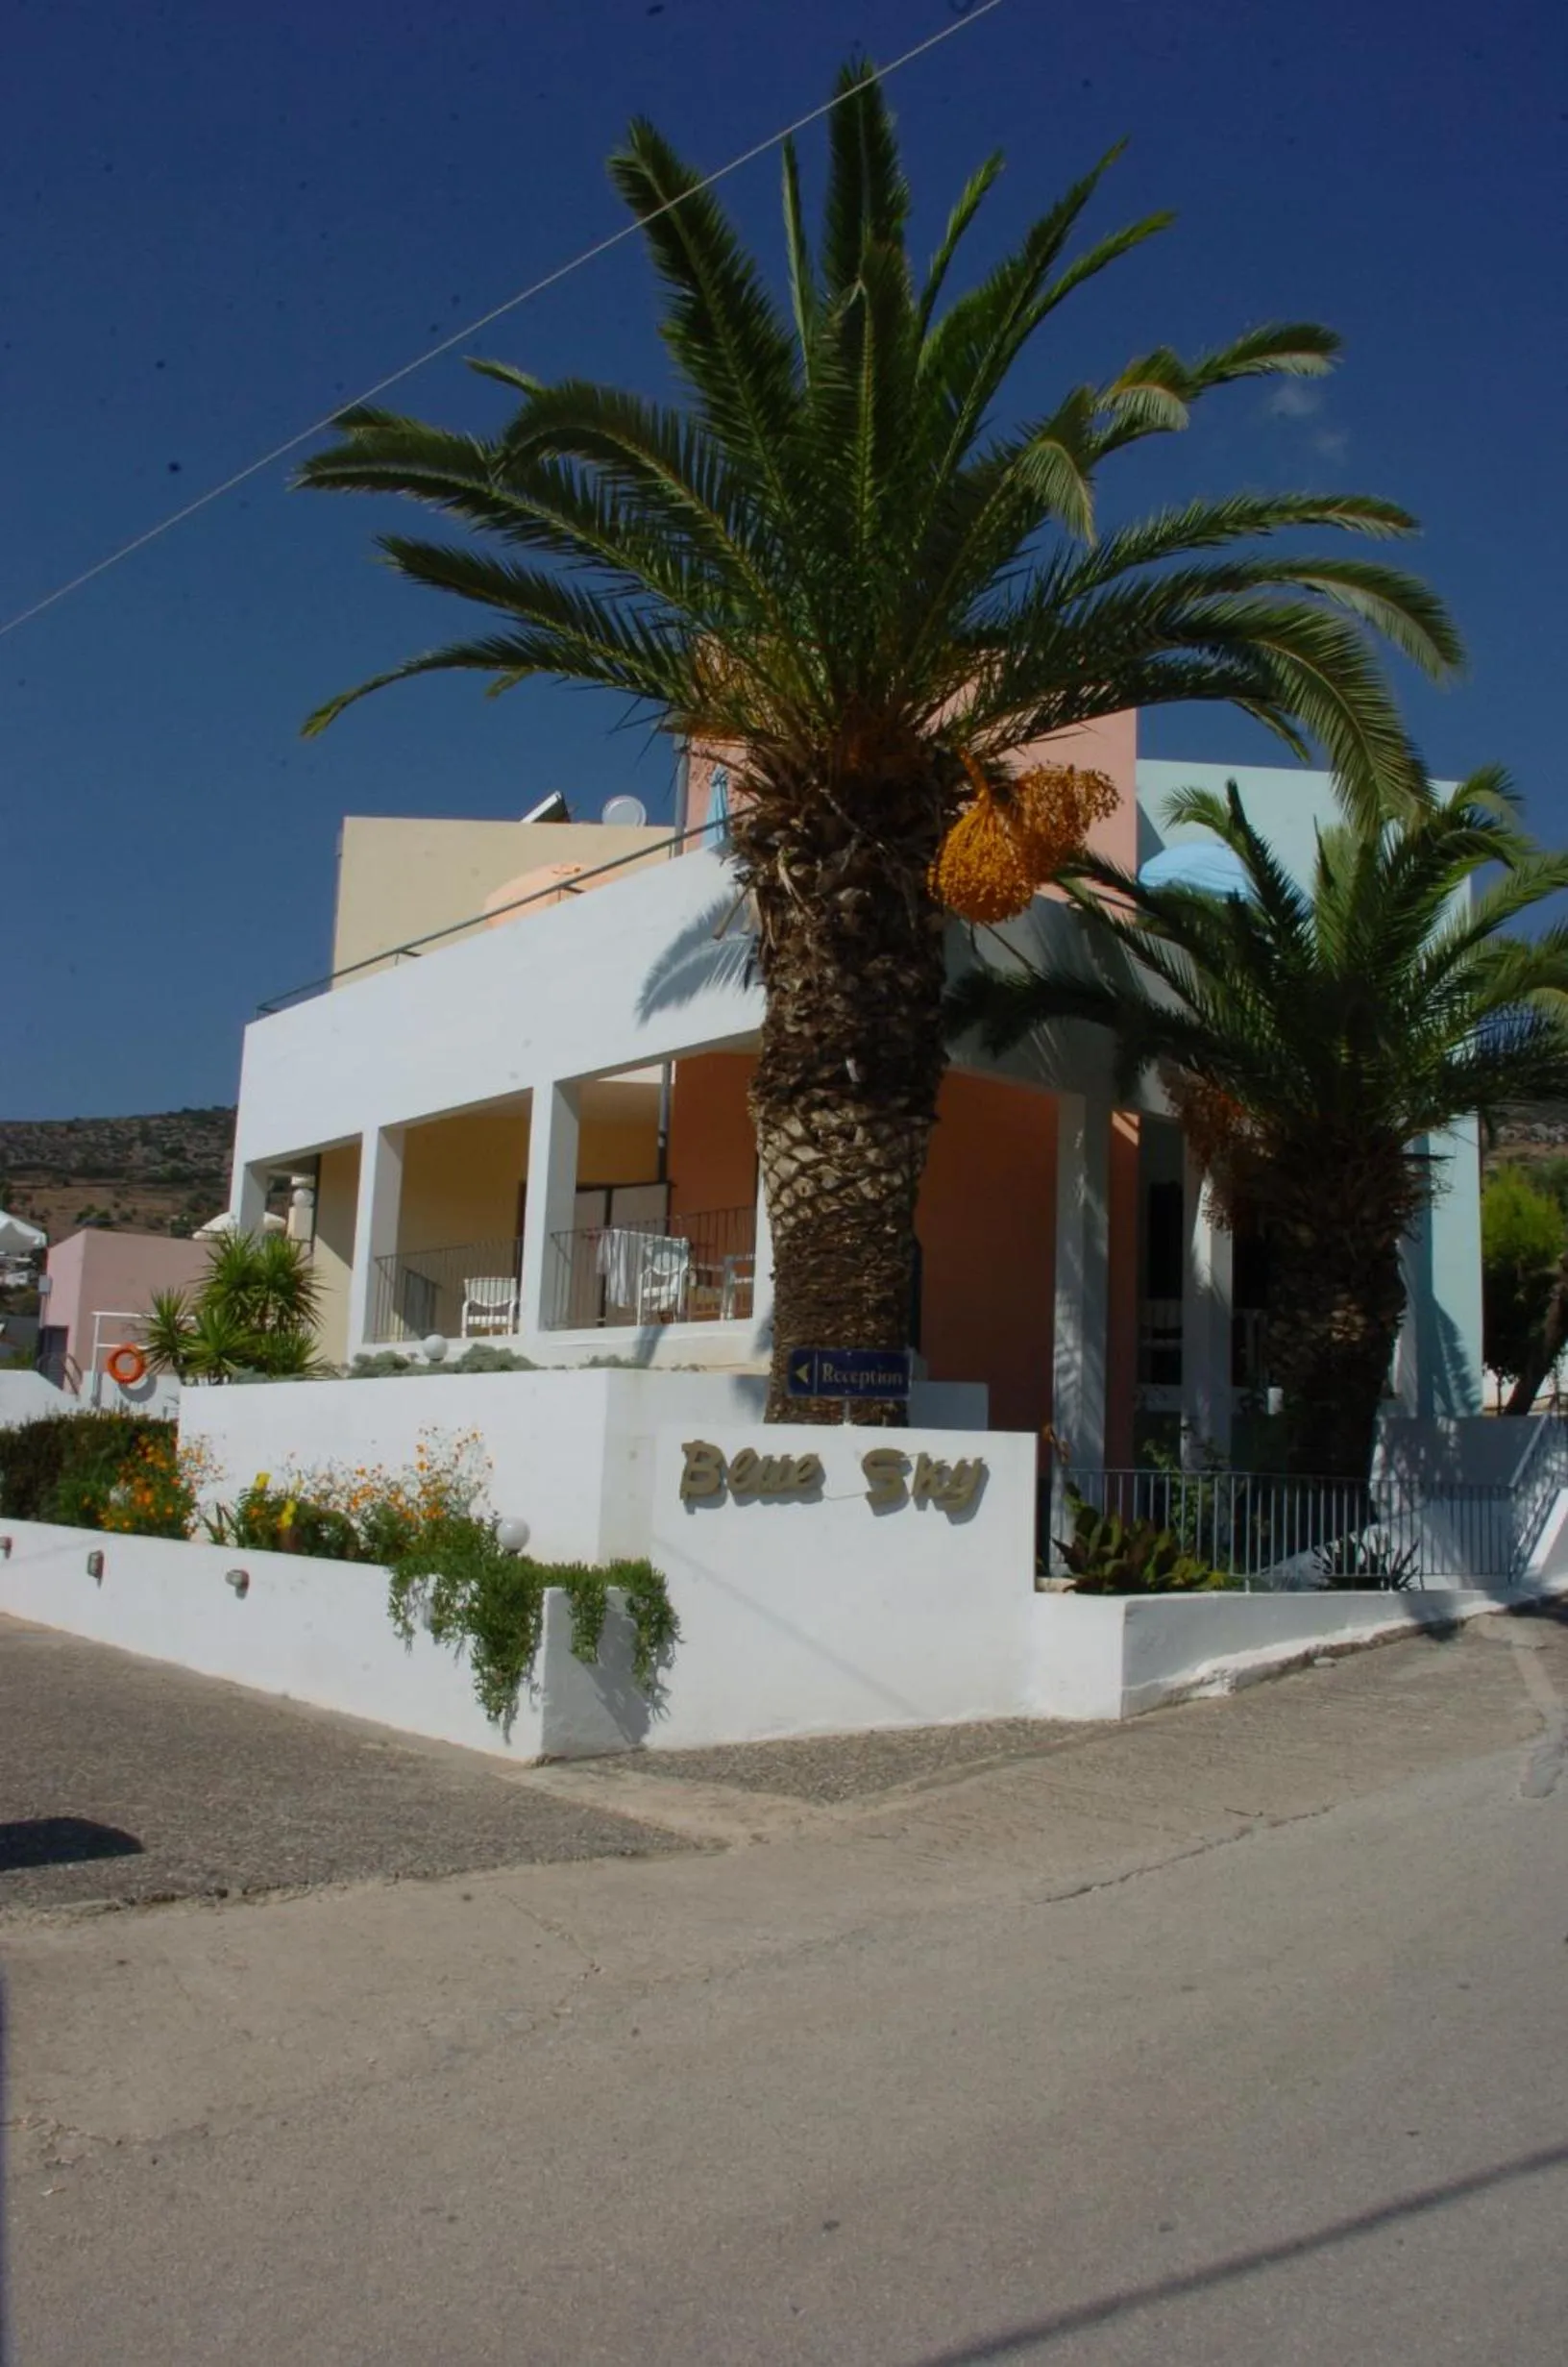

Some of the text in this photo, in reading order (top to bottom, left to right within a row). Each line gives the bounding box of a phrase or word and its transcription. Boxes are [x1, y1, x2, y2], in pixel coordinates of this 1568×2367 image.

[821, 1362, 903, 1390] Reception
[679, 1440, 989, 1516] Blue Sky
